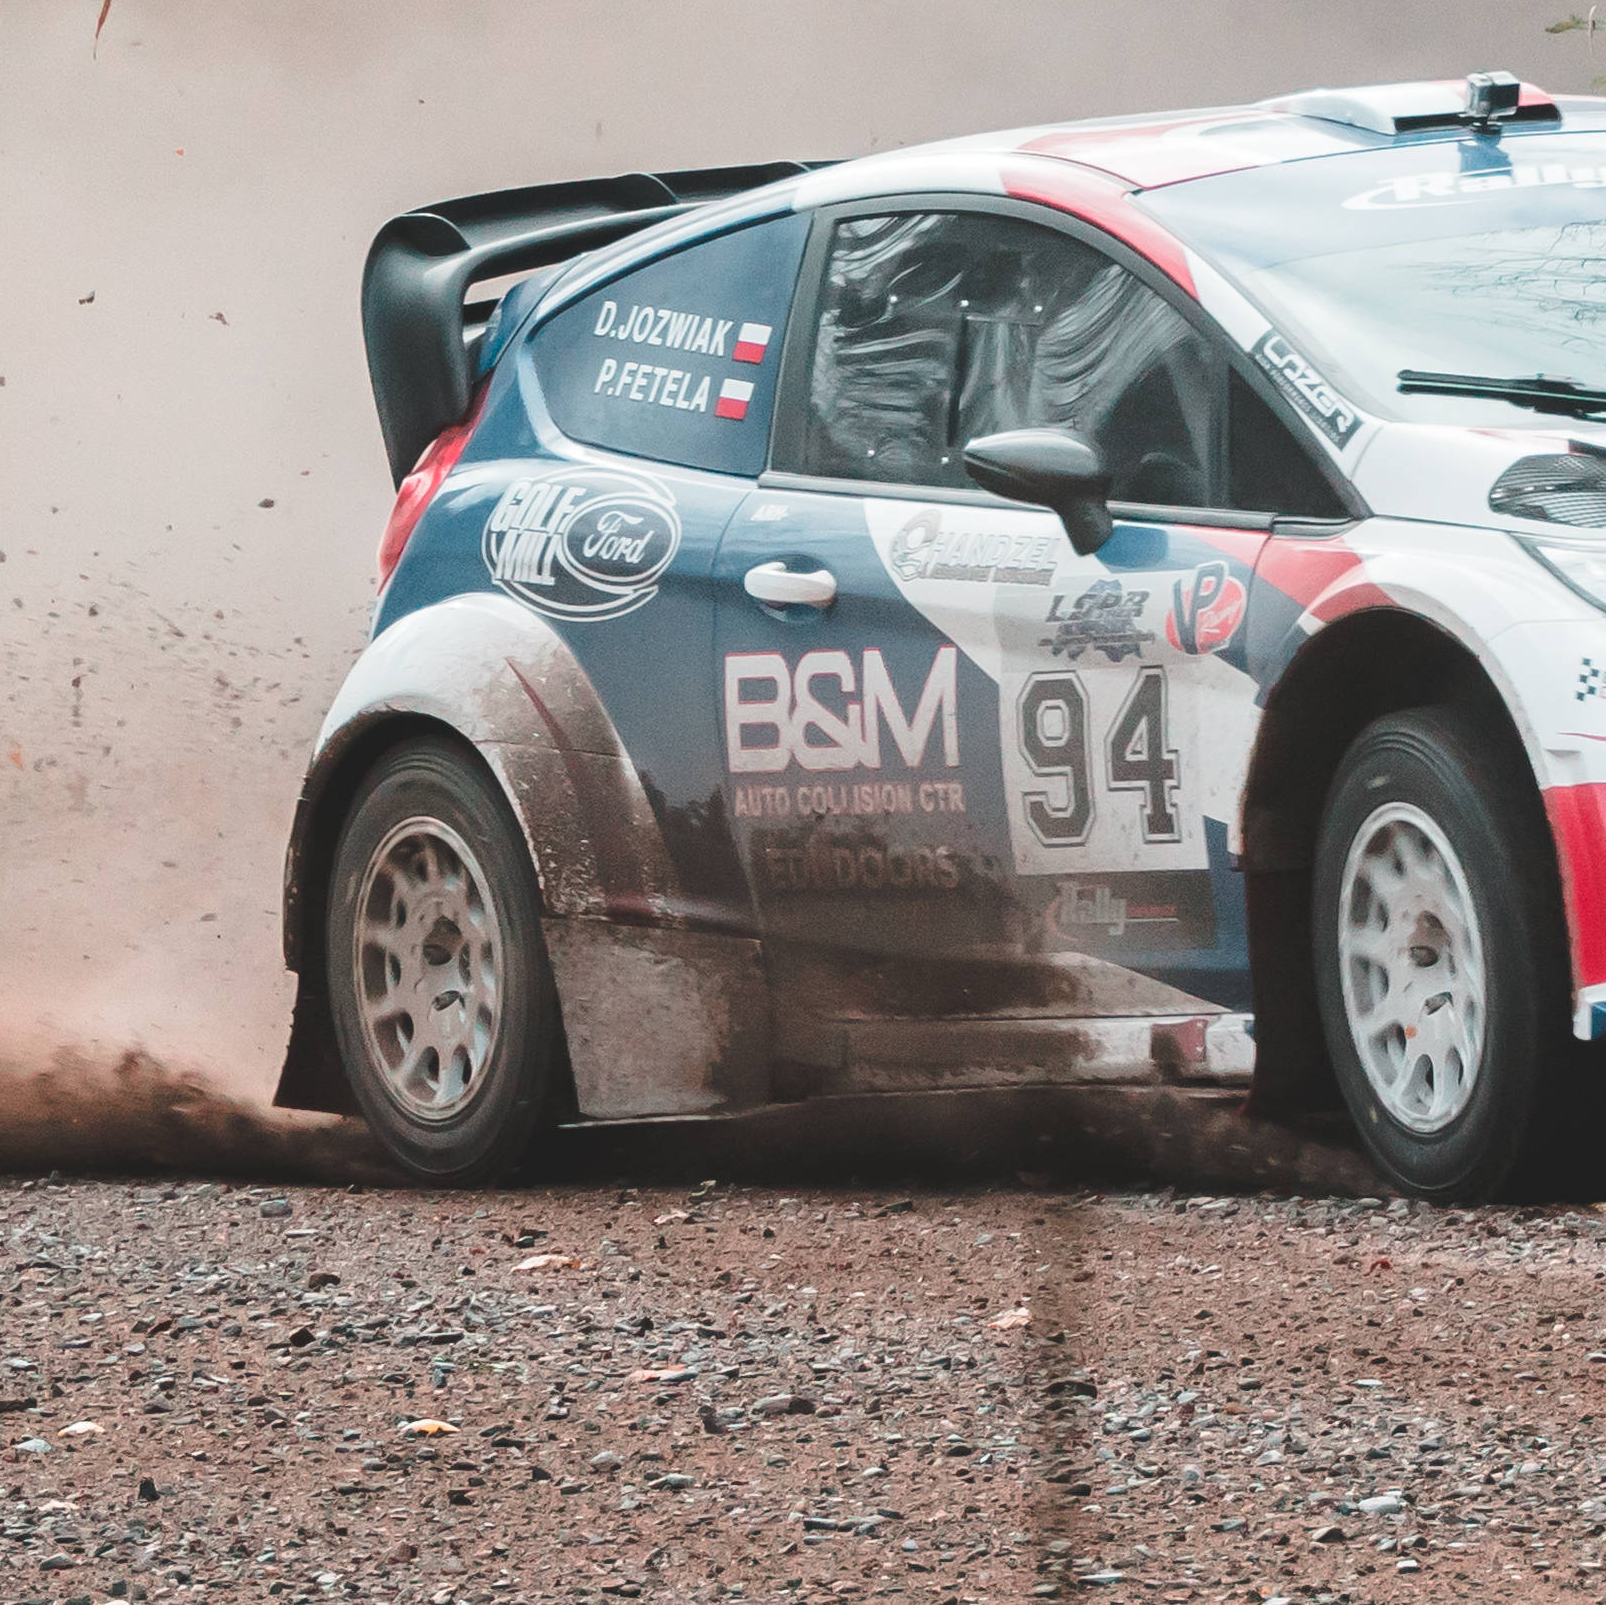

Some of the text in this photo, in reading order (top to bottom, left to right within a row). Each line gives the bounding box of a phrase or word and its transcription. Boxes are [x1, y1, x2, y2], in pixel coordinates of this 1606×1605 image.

[594, 301, 734, 356] D.JOZWIAK
[594, 358, 711, 412] P.FETELA
[583, 510, 655, 564] Ford
[724, 644, 960, 773] B&M
[1016, 665, 1182, 848] 94
[734, 780, 966, 817] AUTO COLLISION CTR
